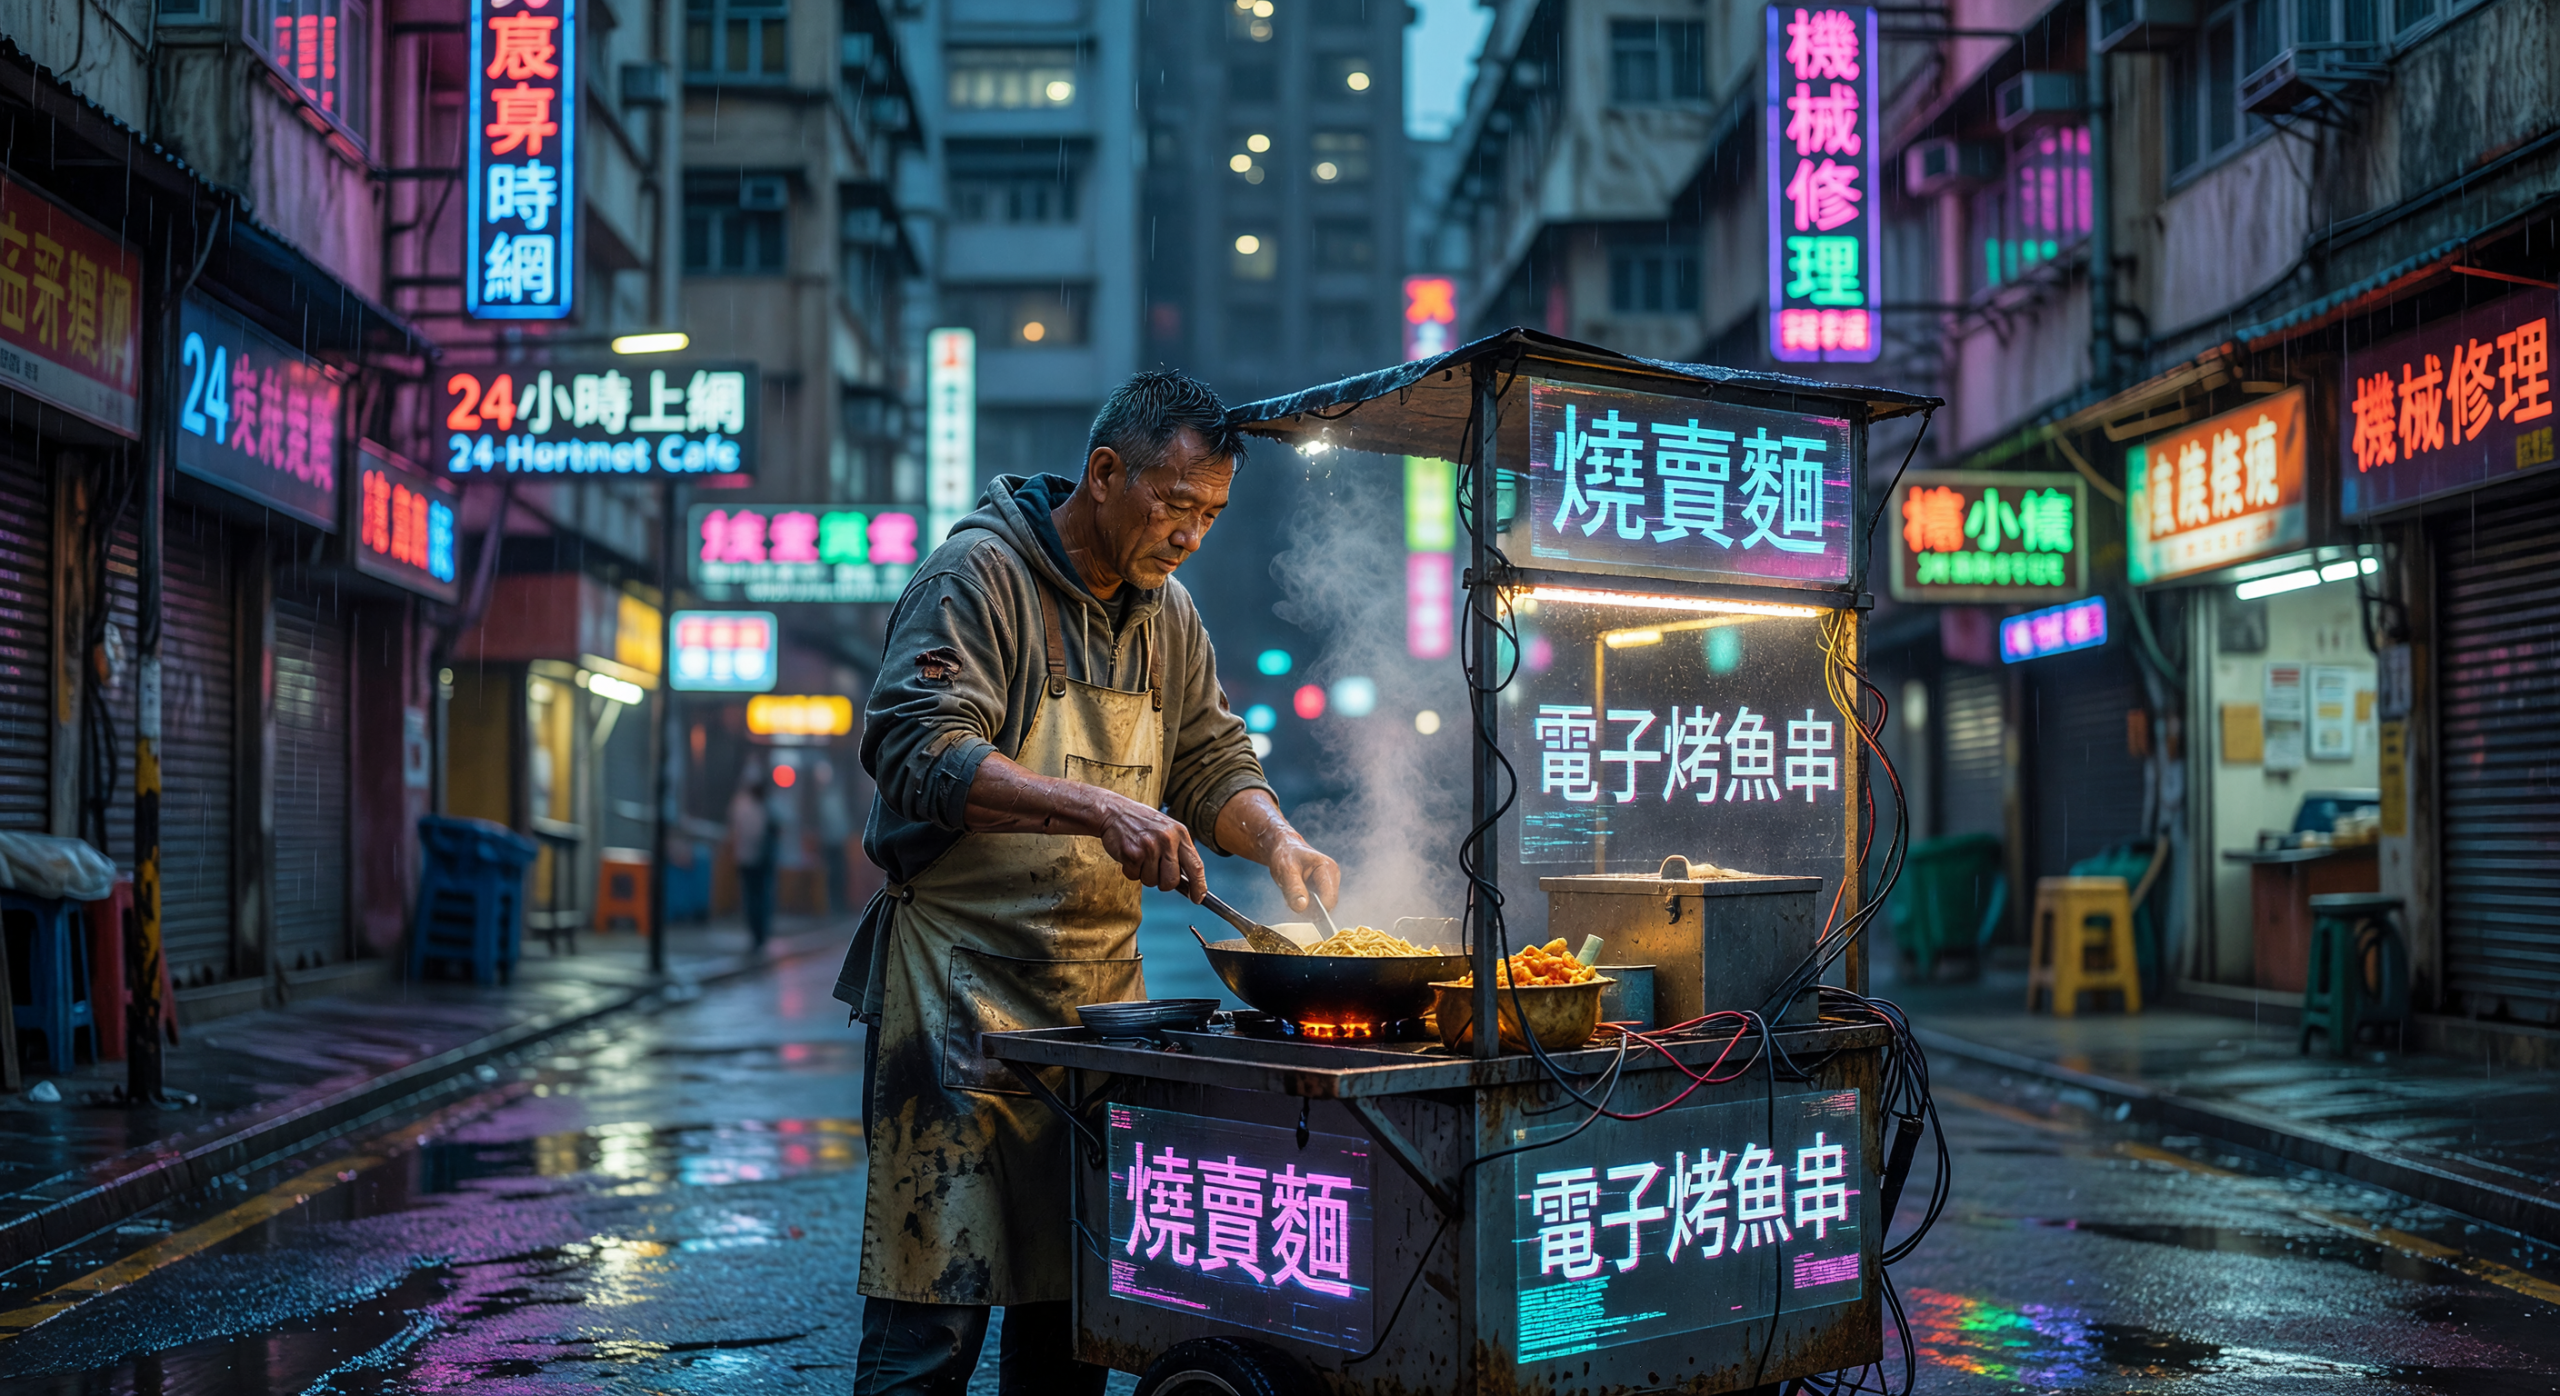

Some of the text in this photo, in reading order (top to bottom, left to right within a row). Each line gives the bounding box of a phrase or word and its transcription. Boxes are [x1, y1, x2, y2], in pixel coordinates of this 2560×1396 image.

[1785, 8, 1864, 307] 機械修理
[2351, 317, 2553, 473] 機械修理
[1552, 403, 1828, 554] 燒賣麵
[1534, 704, 1838, 803] 電子烤魚串
[1125, 1141, 1353, 1298] 燒賣麵
[1531, 1131, 1848, 1282] 電子烤魚串
